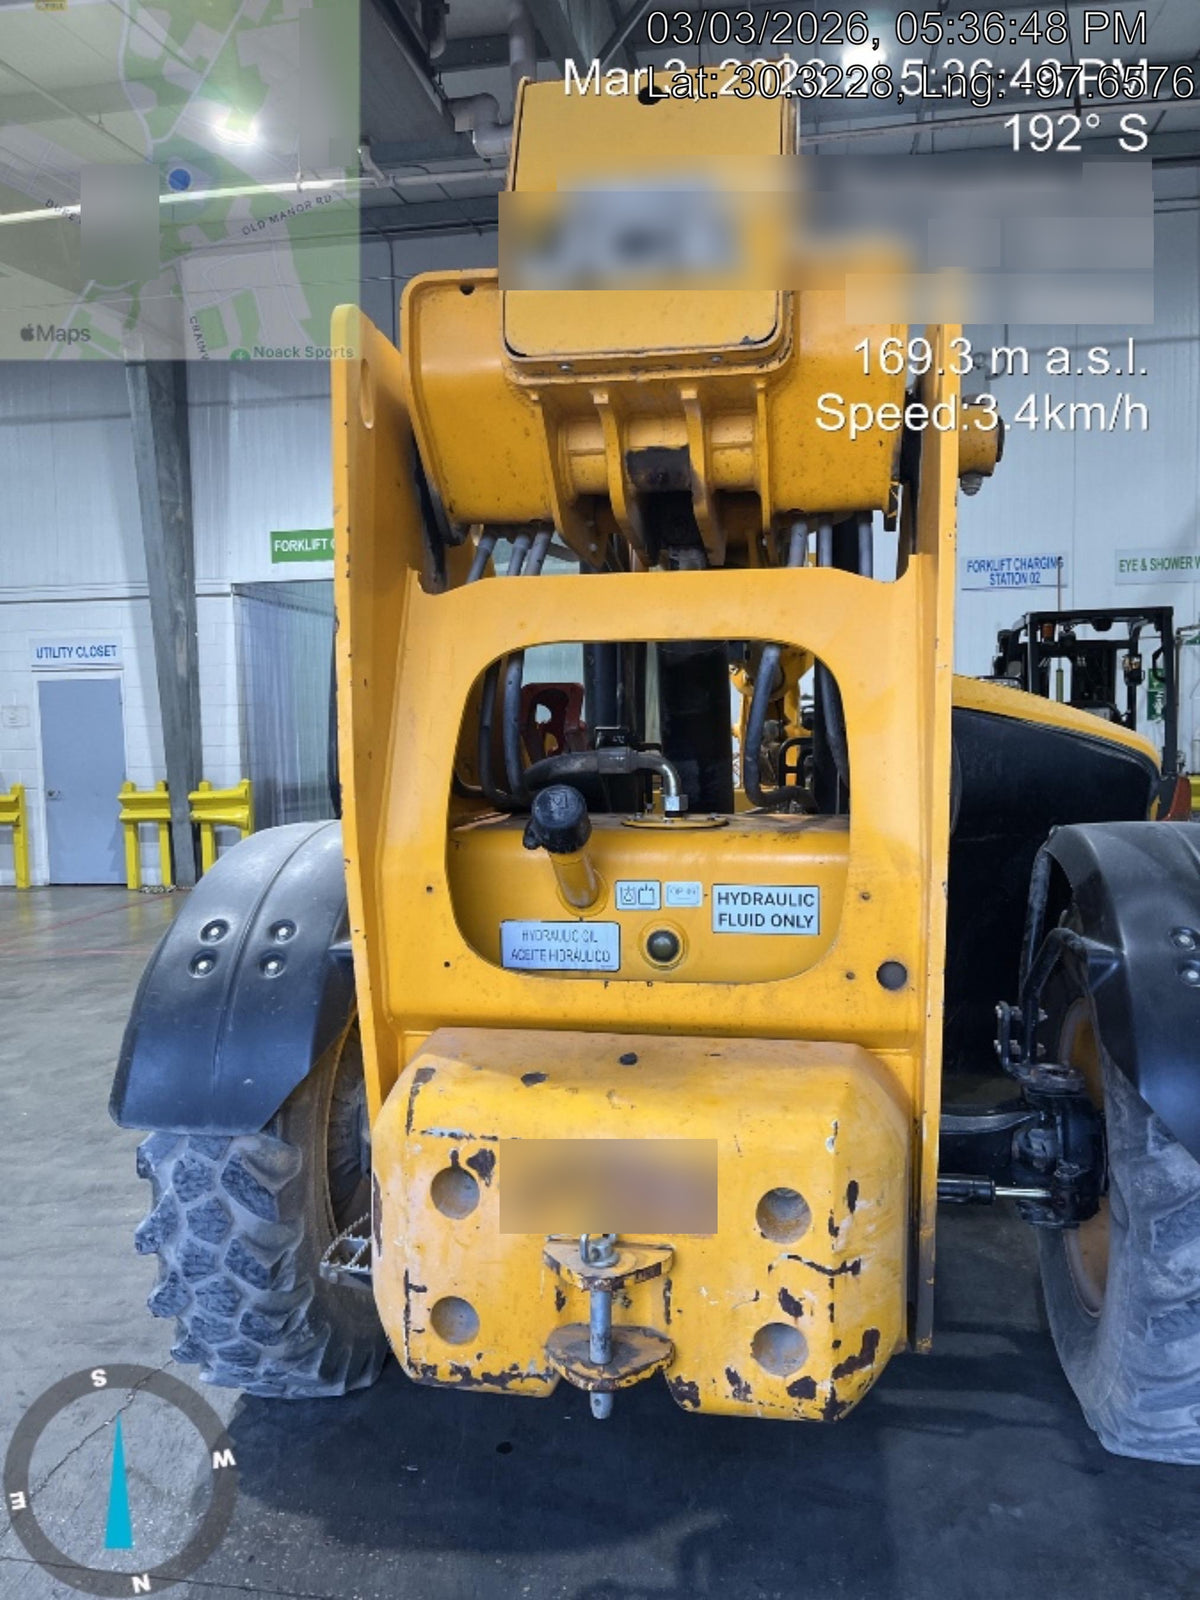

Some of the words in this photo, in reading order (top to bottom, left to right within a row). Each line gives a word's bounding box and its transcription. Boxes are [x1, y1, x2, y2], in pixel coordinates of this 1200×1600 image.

[274, 538, 328, 552] FORKLIFT
[966, 557, 1012, 573] FORKLIFT
[1013, 555, 1064, 572] CHARGING
[1119, 558, 1138, 573] EYE
[1150, 555, 1192, 571] SHOWER
[989, 571, 1028, 586] STATION
[1029, 571, 1041, 584] 02
[36, 645, 74, 660] UTILITY
[76, 644, 118, 658] CLOSET
[716, 891, 816, 908] HYDRAULIC
[717, 913, 765, 928] FLUID
[770, 913, 815, 929] ONLY
